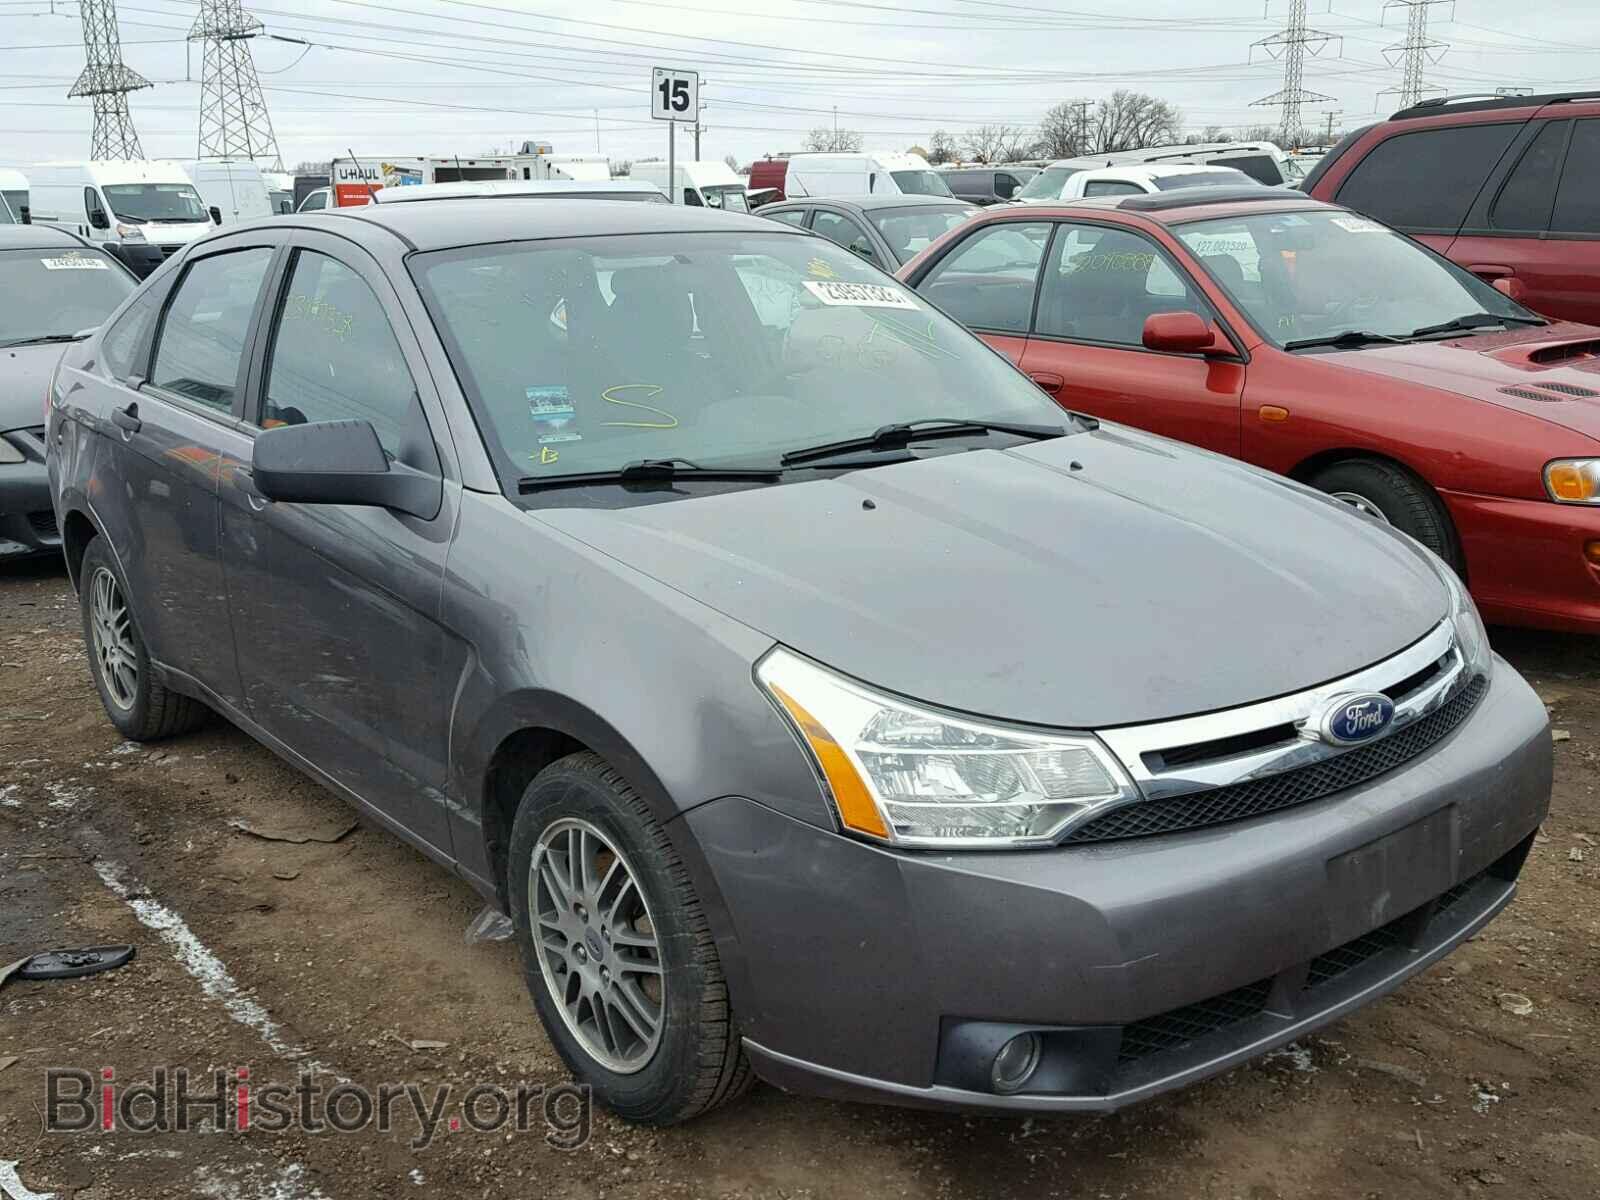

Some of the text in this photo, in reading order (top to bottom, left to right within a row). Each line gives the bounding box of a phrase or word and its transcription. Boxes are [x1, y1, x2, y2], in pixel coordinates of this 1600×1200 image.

[658, 78, 690, 112] 15
[600, 384, 679, 429] S
[1345, 701, 1384, 735] Ford
